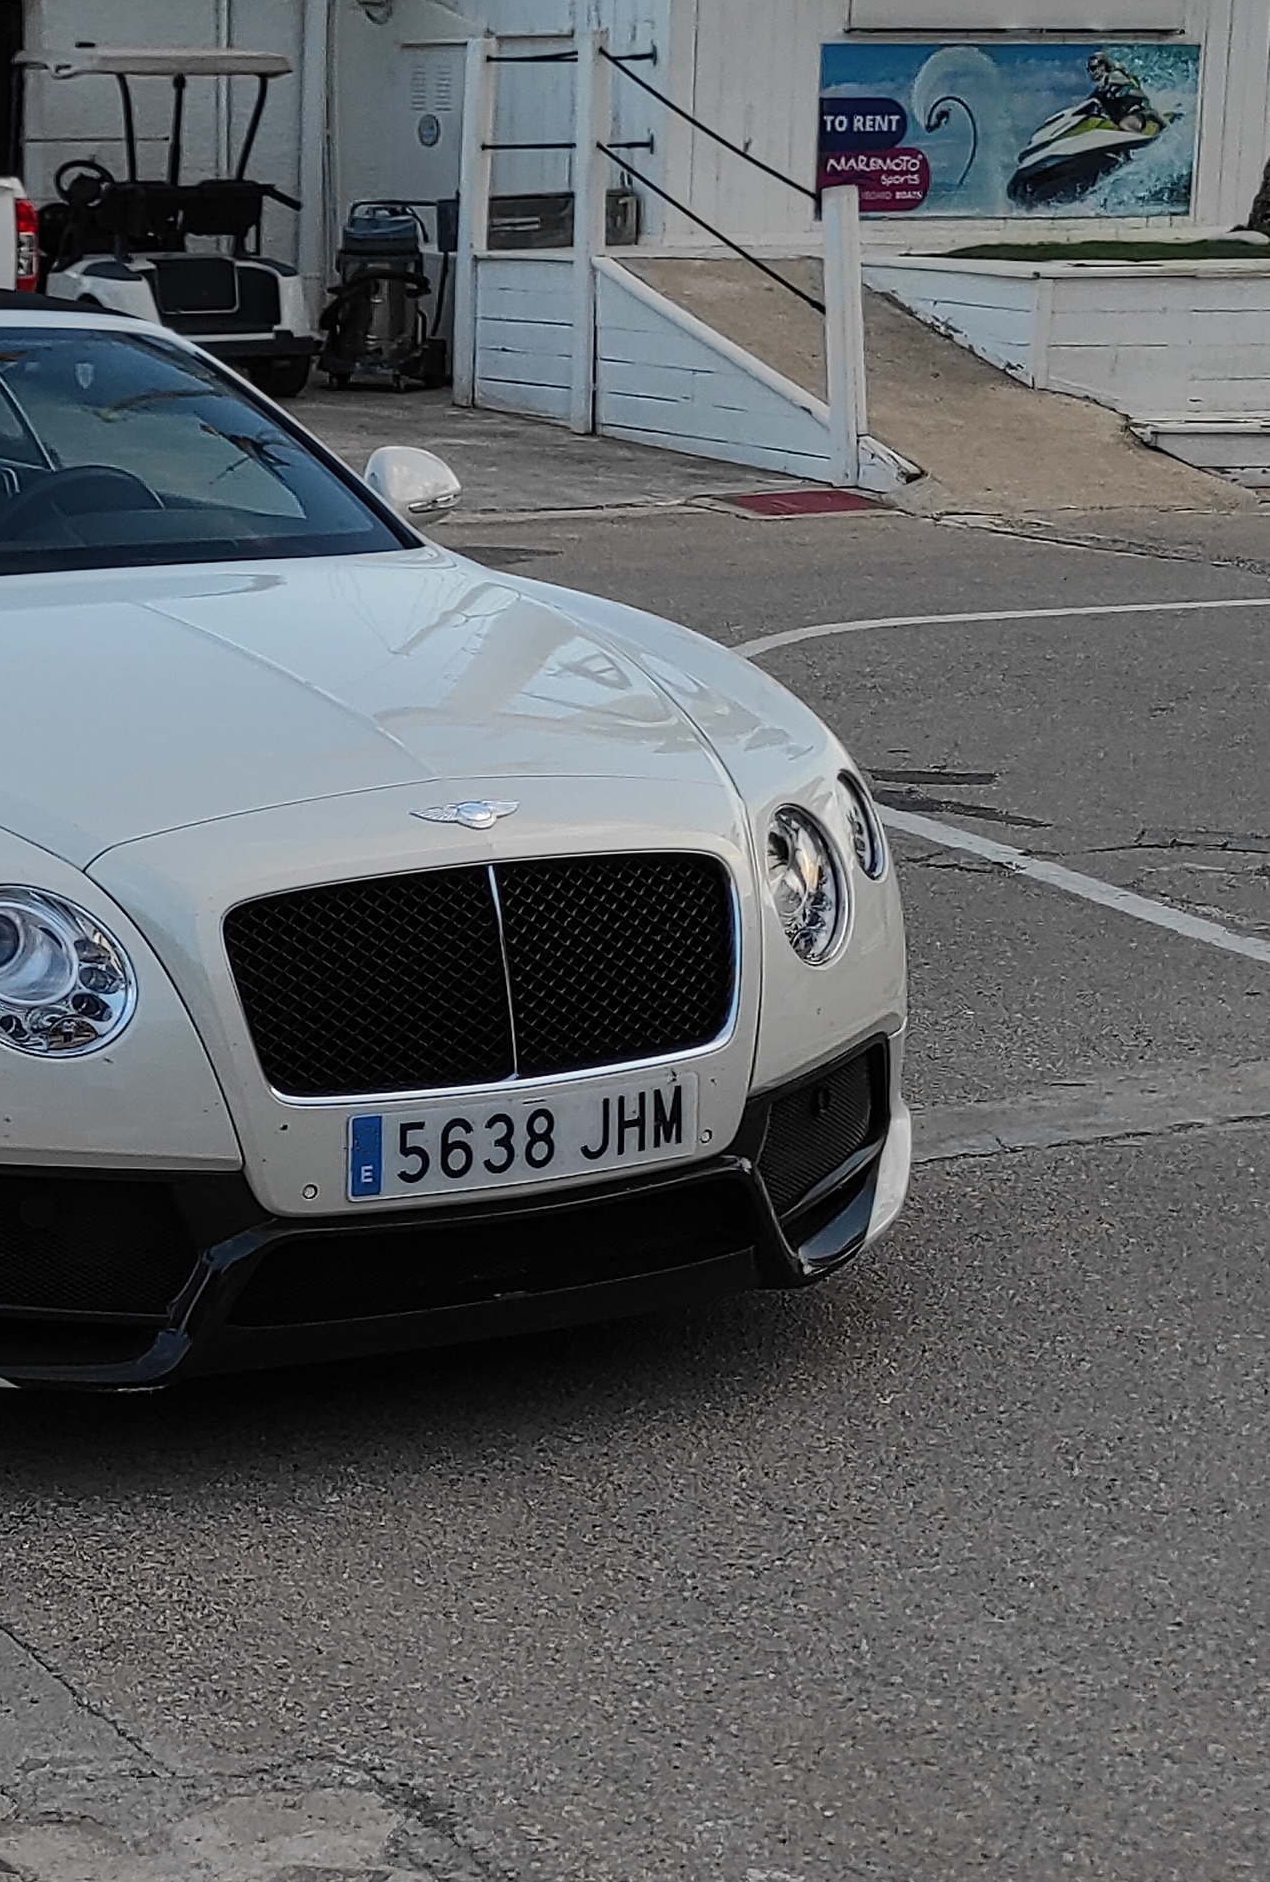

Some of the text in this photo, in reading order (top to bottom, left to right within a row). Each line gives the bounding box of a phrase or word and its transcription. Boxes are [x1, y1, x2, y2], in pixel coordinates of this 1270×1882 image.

[823, 115, 901, 132] TO RENT
[360, 1085, 683, 1184] E 5638 JHM
